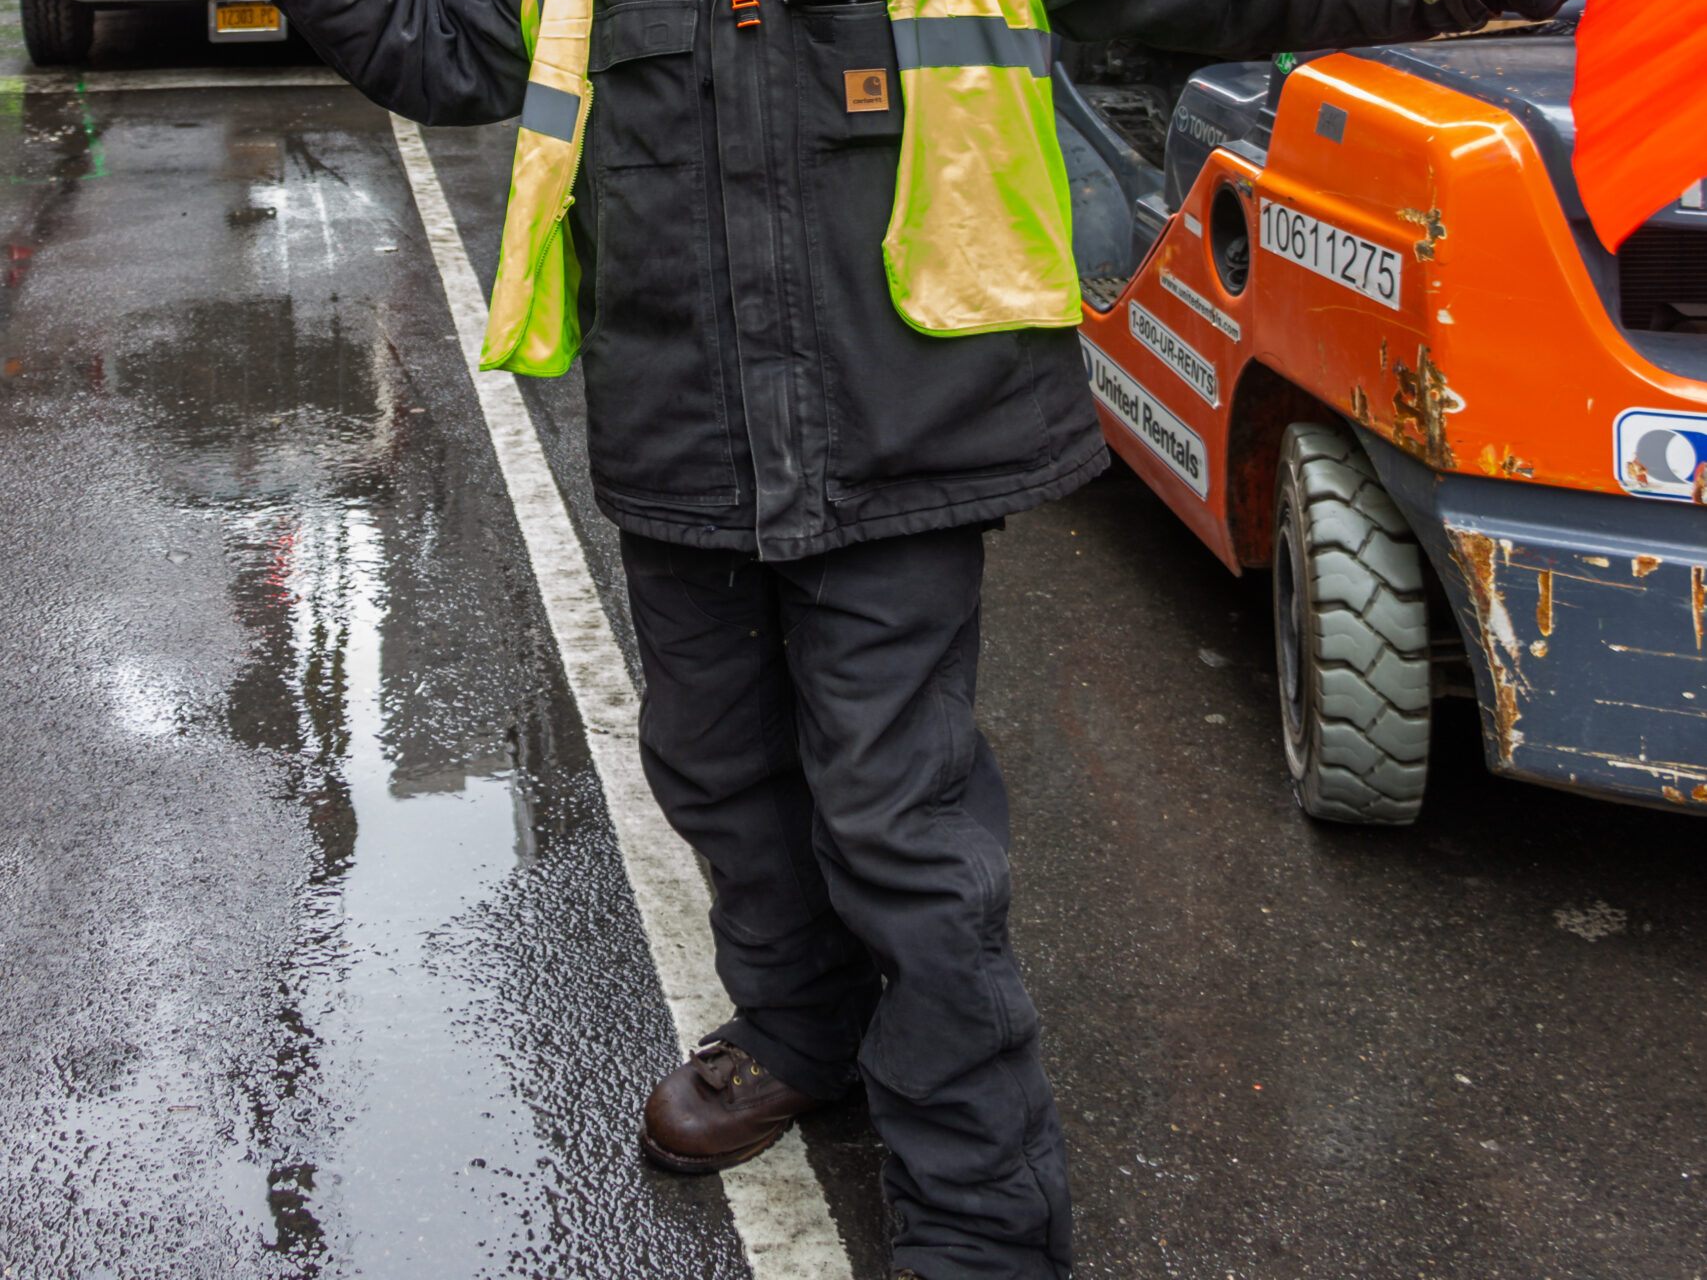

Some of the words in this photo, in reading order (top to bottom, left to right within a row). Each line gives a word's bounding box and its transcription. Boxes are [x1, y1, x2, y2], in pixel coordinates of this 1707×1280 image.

[1262, 203, 1395, 299] 10611275
[1132, 310, 1214, 396] 1-800-UR-RENTS
[1095, 359, 1139, 425] United
[1142, 401, 1199, 479] Rentals
